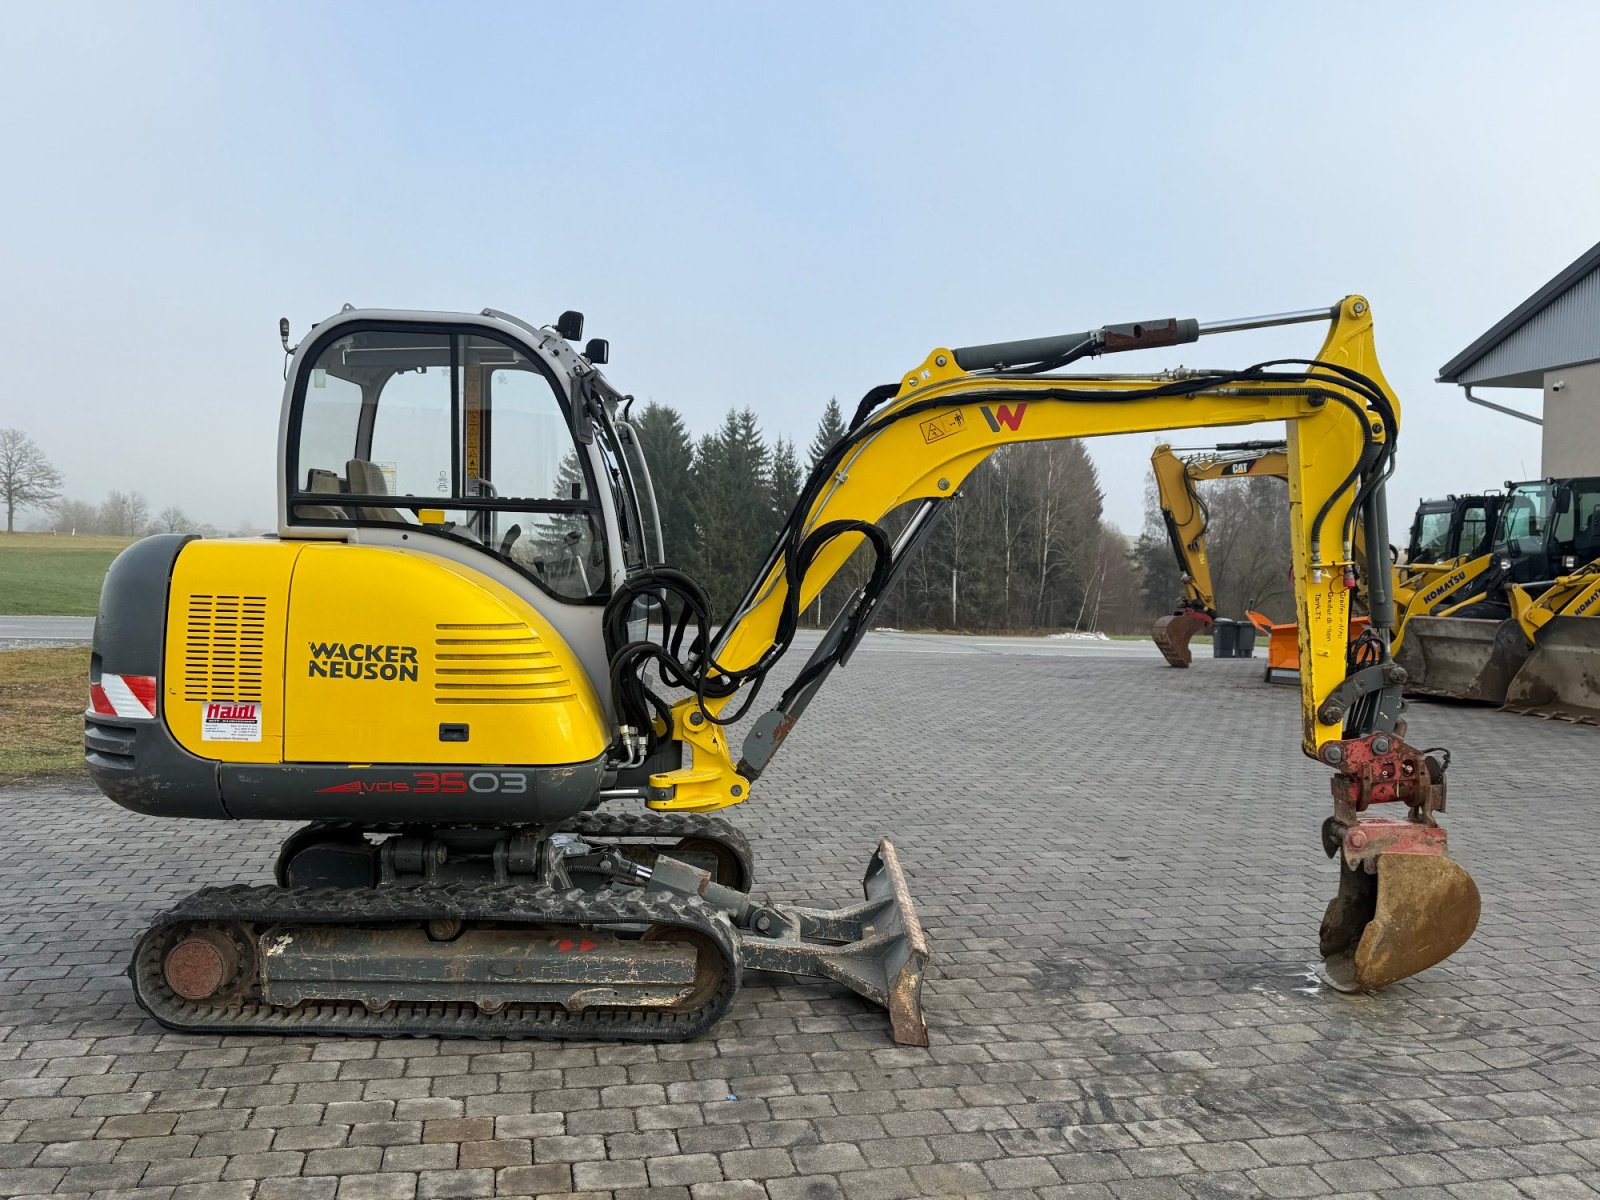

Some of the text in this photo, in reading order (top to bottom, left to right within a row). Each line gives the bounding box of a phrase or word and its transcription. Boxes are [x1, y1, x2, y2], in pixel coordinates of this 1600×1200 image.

[1232, 462, 1248, 474] CAT
[1423, 571, 1466, 604] KOMATSU
[308, 642, 418, 663] WACKER
[308, 660, 418, 682] NEUSON
[207, 703, 257, 719] Haidl
[413, 772, 527, 794] 3503
